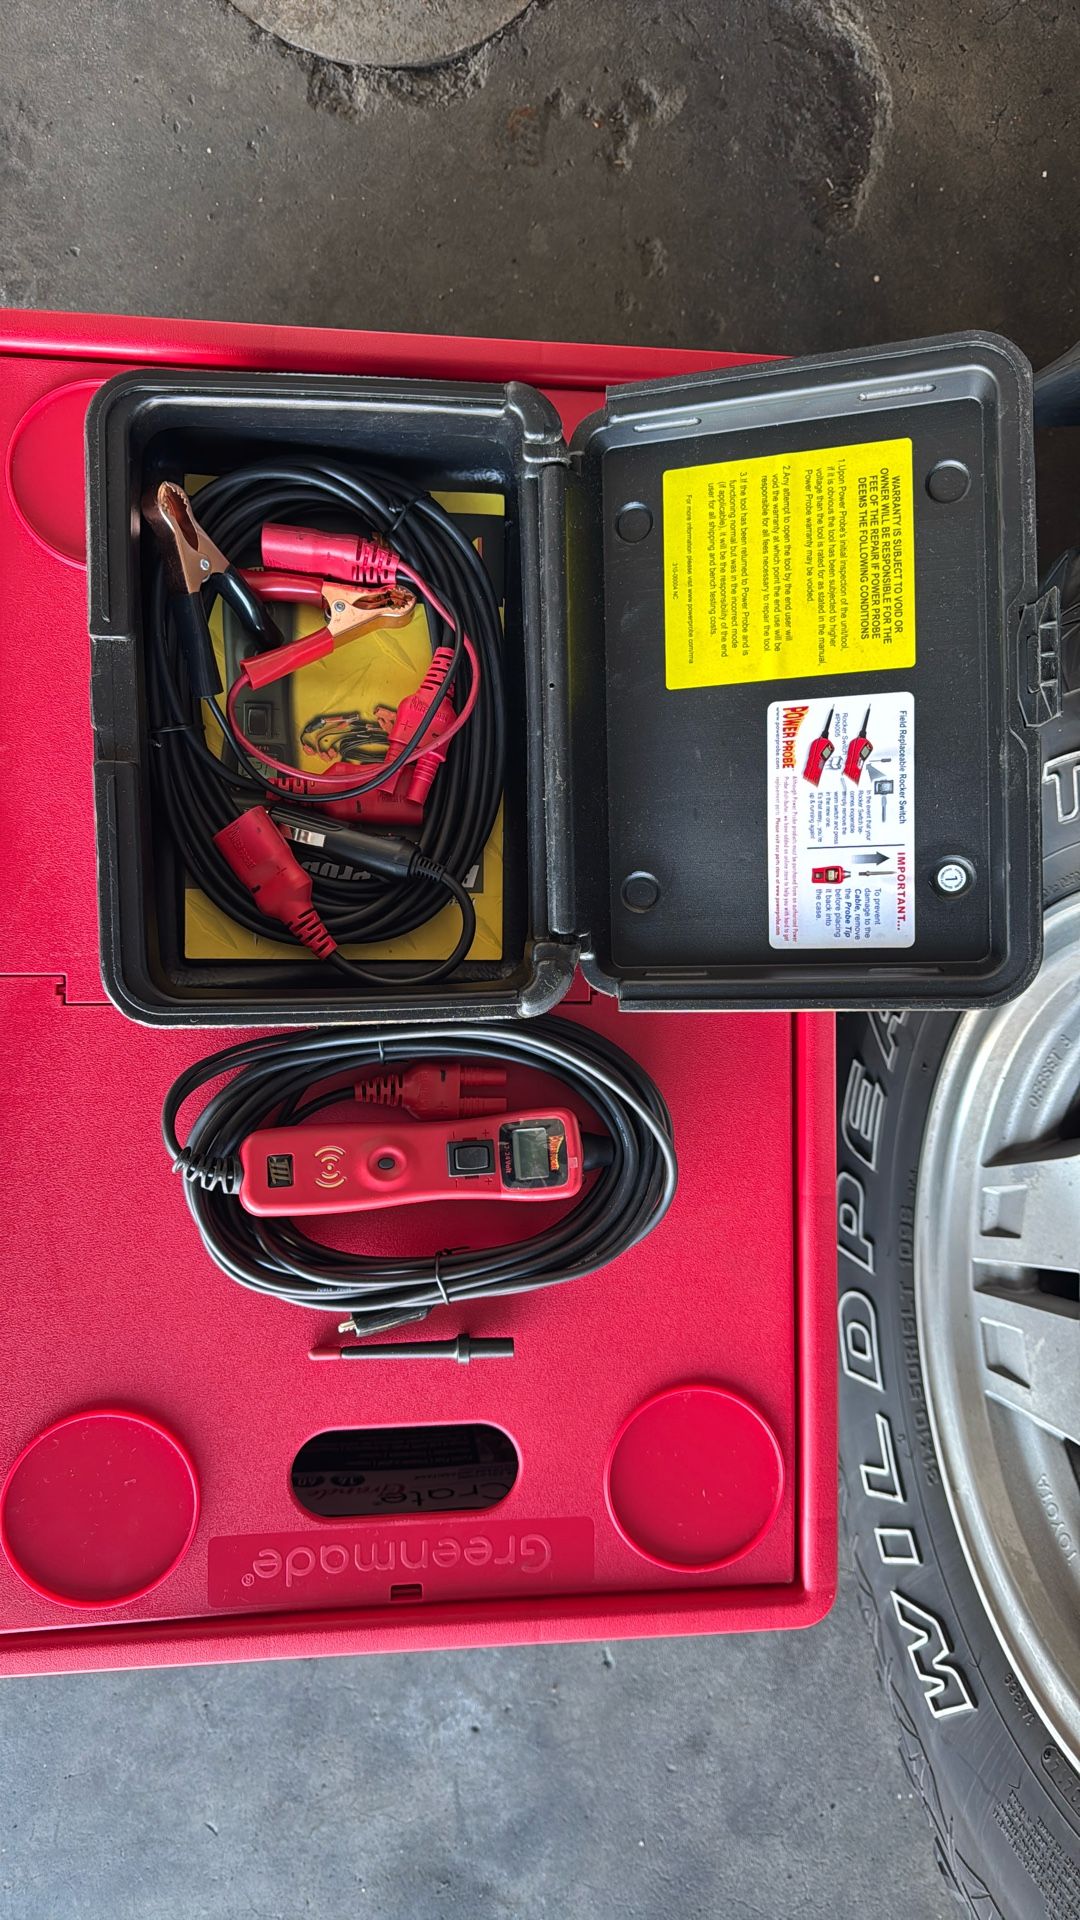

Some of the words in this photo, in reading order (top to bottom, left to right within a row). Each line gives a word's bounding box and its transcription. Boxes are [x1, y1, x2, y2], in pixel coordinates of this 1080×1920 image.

[772, 473, 780, 488] void
[805, 468, 814, 491] Power
[815, 467, 825, 494] voltage
[869, 474, 879, 492] FEE
[880, 467, 890, 501] OWNER
[728, 479, 738, 518] functioning
[761, 475, 770, 515] responsible
[783, 487, 791, 514] attempt
[817, 494, 825, 511] than
[828, 486, 836, 514] obvious
[839, 485, 847, 509] Power
[858, 476, 868, 508] DEEMS
[870, 494, 879, 506] OF
[892, 475, 902, 525] WARRANTY
[708, 499, 717, 509] for
[806, 493, 814, 515] Probe
[881, 502, 890, 525] WILL
[762, 517, 771, 527] for
[771, 502, 781, 533] warranty
[817, 512, 825, 524] the
[828, 515, 836, 527] the
[839, 510, 848, 538] Probe's
[859, 509, 868, 528] THE
[870, 507, 880, 526] THE
[708, 520, 717, 551] shipping
[730, 519, 738, 544] normal
[762, 528, 771, 537] all
[783, 524, 791, 543] open
[805, 516, 814, 548] warranty
[817, 525, 825, 539] tool
[828, 528, 837, 542] tool
[881, 526, 891, 539] BE
[893, 527, 902, 536] IS
[730, 545, 738, 557] but
[763, 538, 771, 554] fees
[773, 543, 781, 565] which
[784, 544, 792, 556] the
[829, 543, 837, 557] has
[840, 539, 848, 558] initial
[870, 527, 880, 560] REPAIR
[709, 552, 717, 566] and
[784, 557, 793, 571] tool
[805, 549, 813, 565] may
[817, 548, 826, 567] rated
[859, 529, 869, 583] FOLLOWING
[871, 562, 880, 570] IF
[893, 538, 903, 579] SUBJECT
[709, 567, 717, 589] bench
[762, 555, 770, 592] necessary
[772, 566, 781, 584] point
[783, 572, 793, 581] by
[807, 566, 815, 576] be
[818, 569, 826, 579] for
[829, 558, 837, 577] been
[839, 559, 848, 596] inspection
[882, 540, 892, 603] RESPONSIBLE
[774, 585, 782, 597] the
[785, 583, 793, 594] the
[818, 580, 825, 590] as
[871, 572, 881, 606] POWER
[894, 580, 903, 594] TO
[709, 590, 717, 614] testing
[774, 598, 782, 612] end
[785, 596, 793, 610] end
[818, 591, 826, 613] stated
[828, 579, 838, 613] subjected
[894, 595, 904, 617] VOID
[731, 596, 739, 626] incorrect
[762, 602, 770, 623] repair
[841, 606, 849, 618] the
[860, 584, 870, 639] CONDITIONS
[883, 605, 893, 624] FOR
[818, 623, 826, 635] the
[872, 607, 881, 639] PROBE
[894, 619, 904, 633] OR
[775, 628, 783, 640] will
[829, 624, 838, 647] higher
[883, 625, 893, 644] THE
[774, 641, 782, 651] be
[783, 705, 810, 738] POWER
[900, 710, 908, 728] Field
[783, 739, 796, 769] PROBE
[899, 729, 908, 772] Replaceable
[899, 773, 908, 798] Rocker
[899, 800, 908, 824] Switch
[835, 888, 843, 911] before
[854, 888, 862, 911] Cable,
[863, 887, 872, 916] damage
[874, 887, 882, 896] To
[845, 901, 853, 924] Probe
[873, 898, 881, 924] prevent
[834, 912, 842, 937] placing
[844, 926, 853, 937] Tip
[837, 1011, 977, 1718] WILDPEA
[1036, 1473, 1077, 1561] TOYOTA
